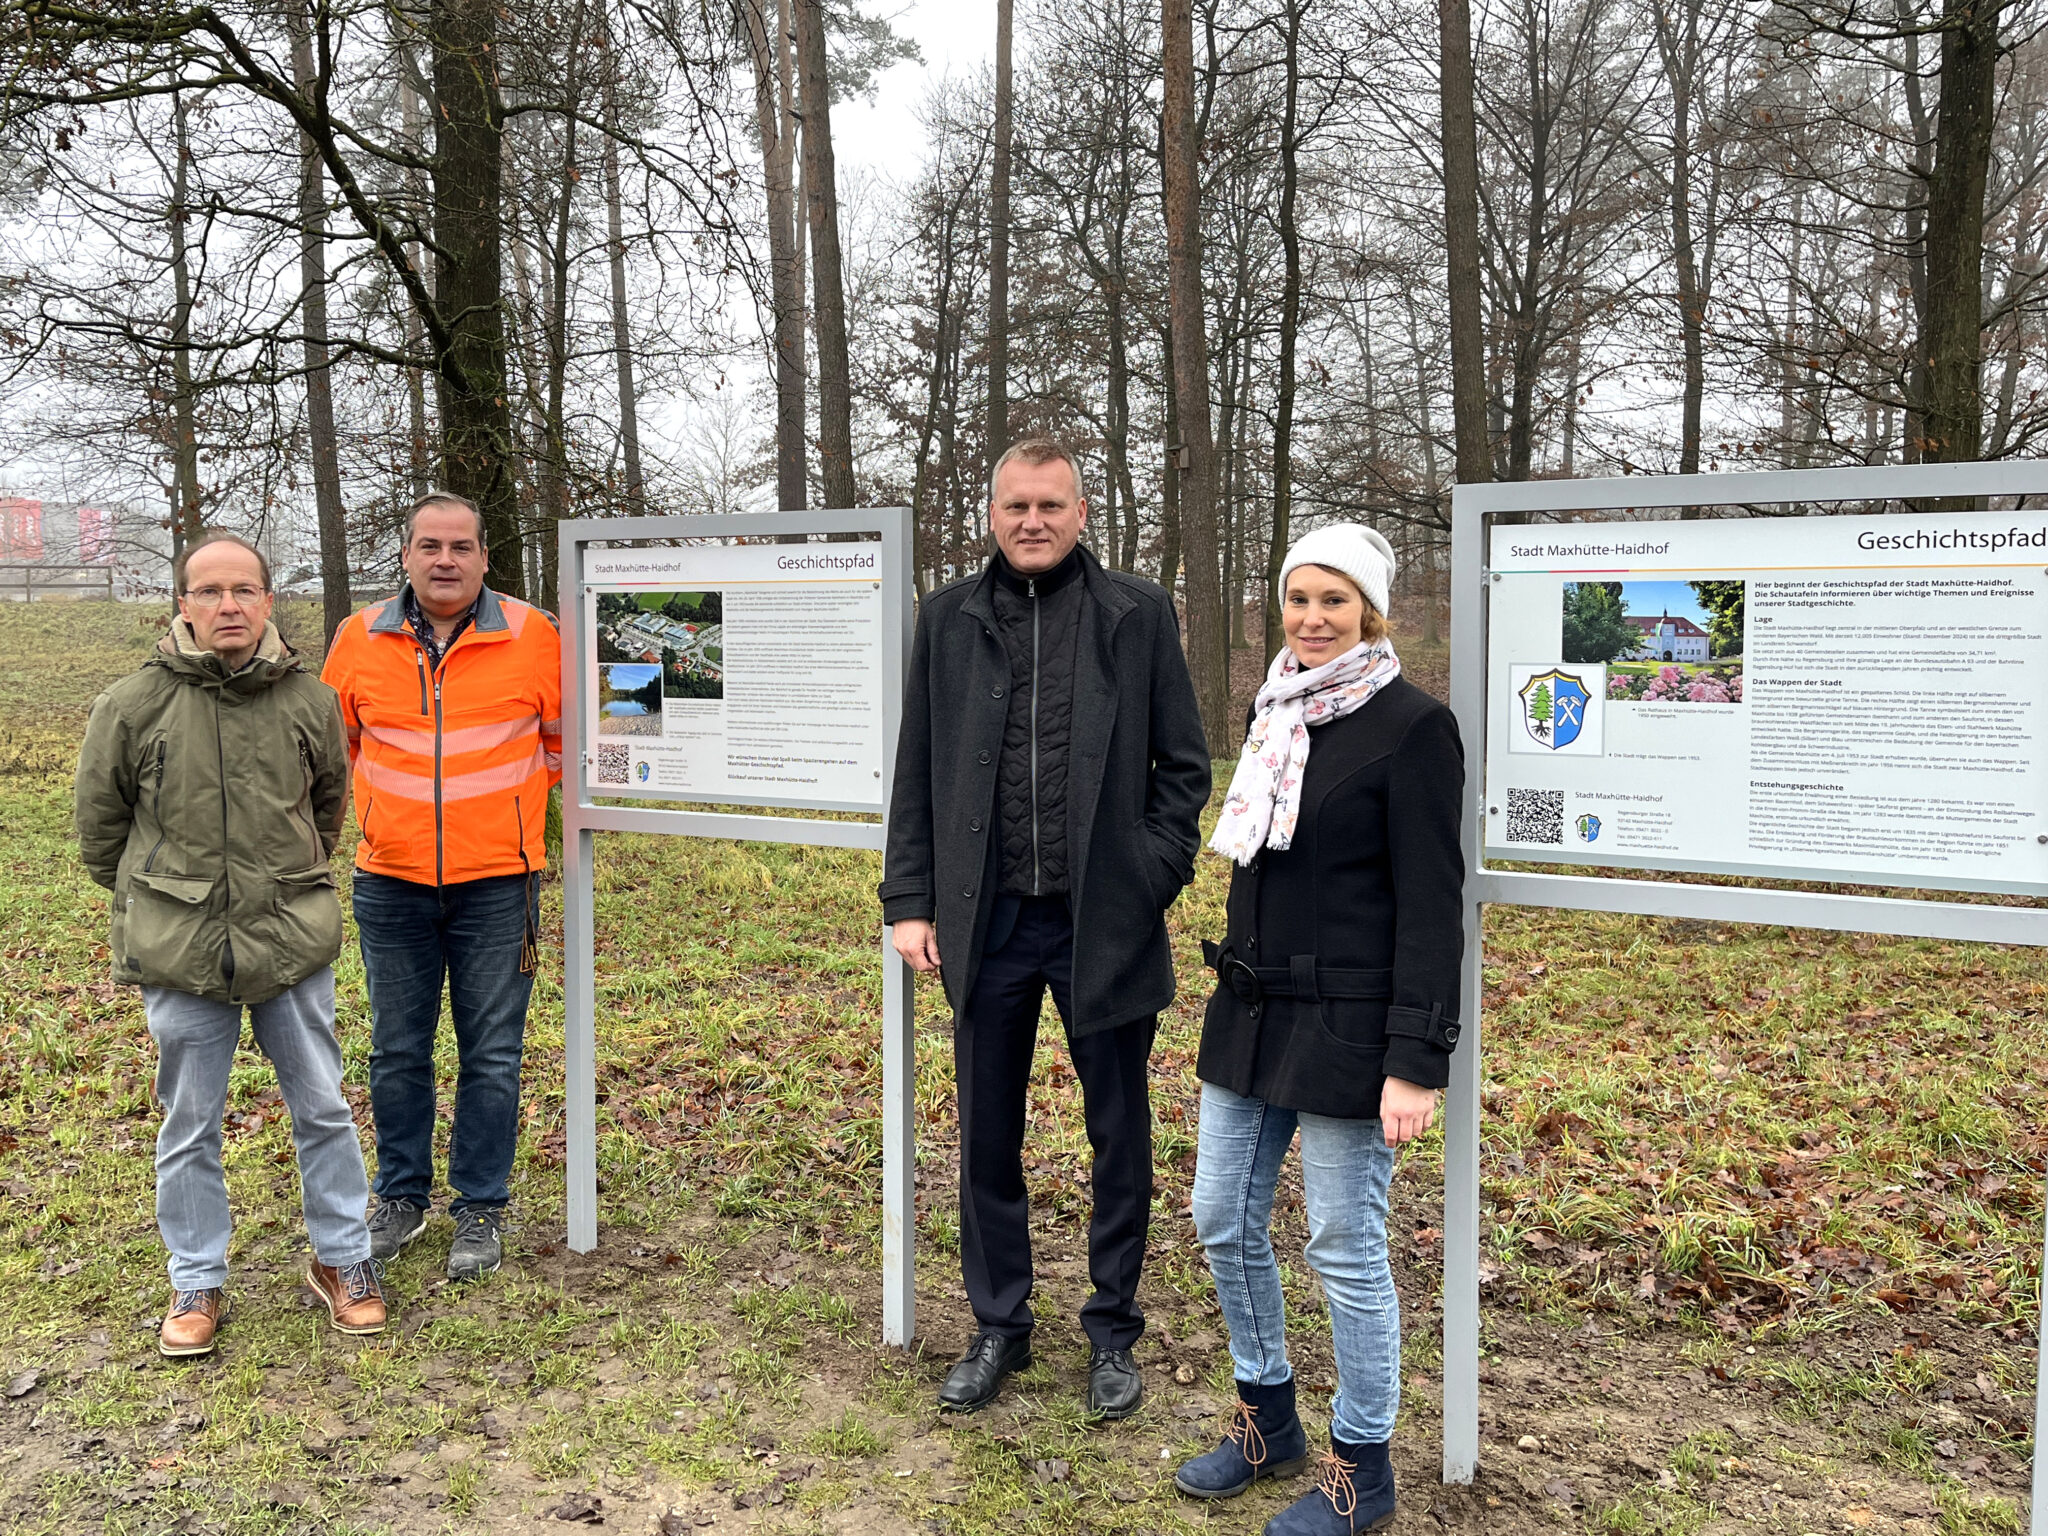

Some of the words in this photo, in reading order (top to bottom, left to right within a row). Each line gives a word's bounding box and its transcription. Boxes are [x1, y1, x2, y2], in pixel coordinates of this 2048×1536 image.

[1857, 527, 2046, 552] Geschichtspfad
[1510, 544, 1544, 557] Stadt
[1547, 541, 1670, 557] Maxhütte-Haidhof
[595, 564, 614, 573] Stadt
[615, 562, 681, 573] Maxhütte-Haidhof
[777, 553, 874, 572] Geschichtspfad
[1774, 581, 1805, 590] beginnt
[1823, 580, 1888, 589] Geschichtspfad
[1895, 590, 1932, 598] wichtige
[1990, 590, 2034, 598] Ereignisse
[1788, 600, 1856, 608] Stadtgeschichte.
[1754, 616, 1773, 624] Lage
[1769, 679, 1802, 687] Wappen
[1750, 780, 1844, 792] Entstehungsgeschichte
[1575, 791, 1594, 799] Stadt
[1595, 792, 1663, 802] Maxhütte-Haidhof
